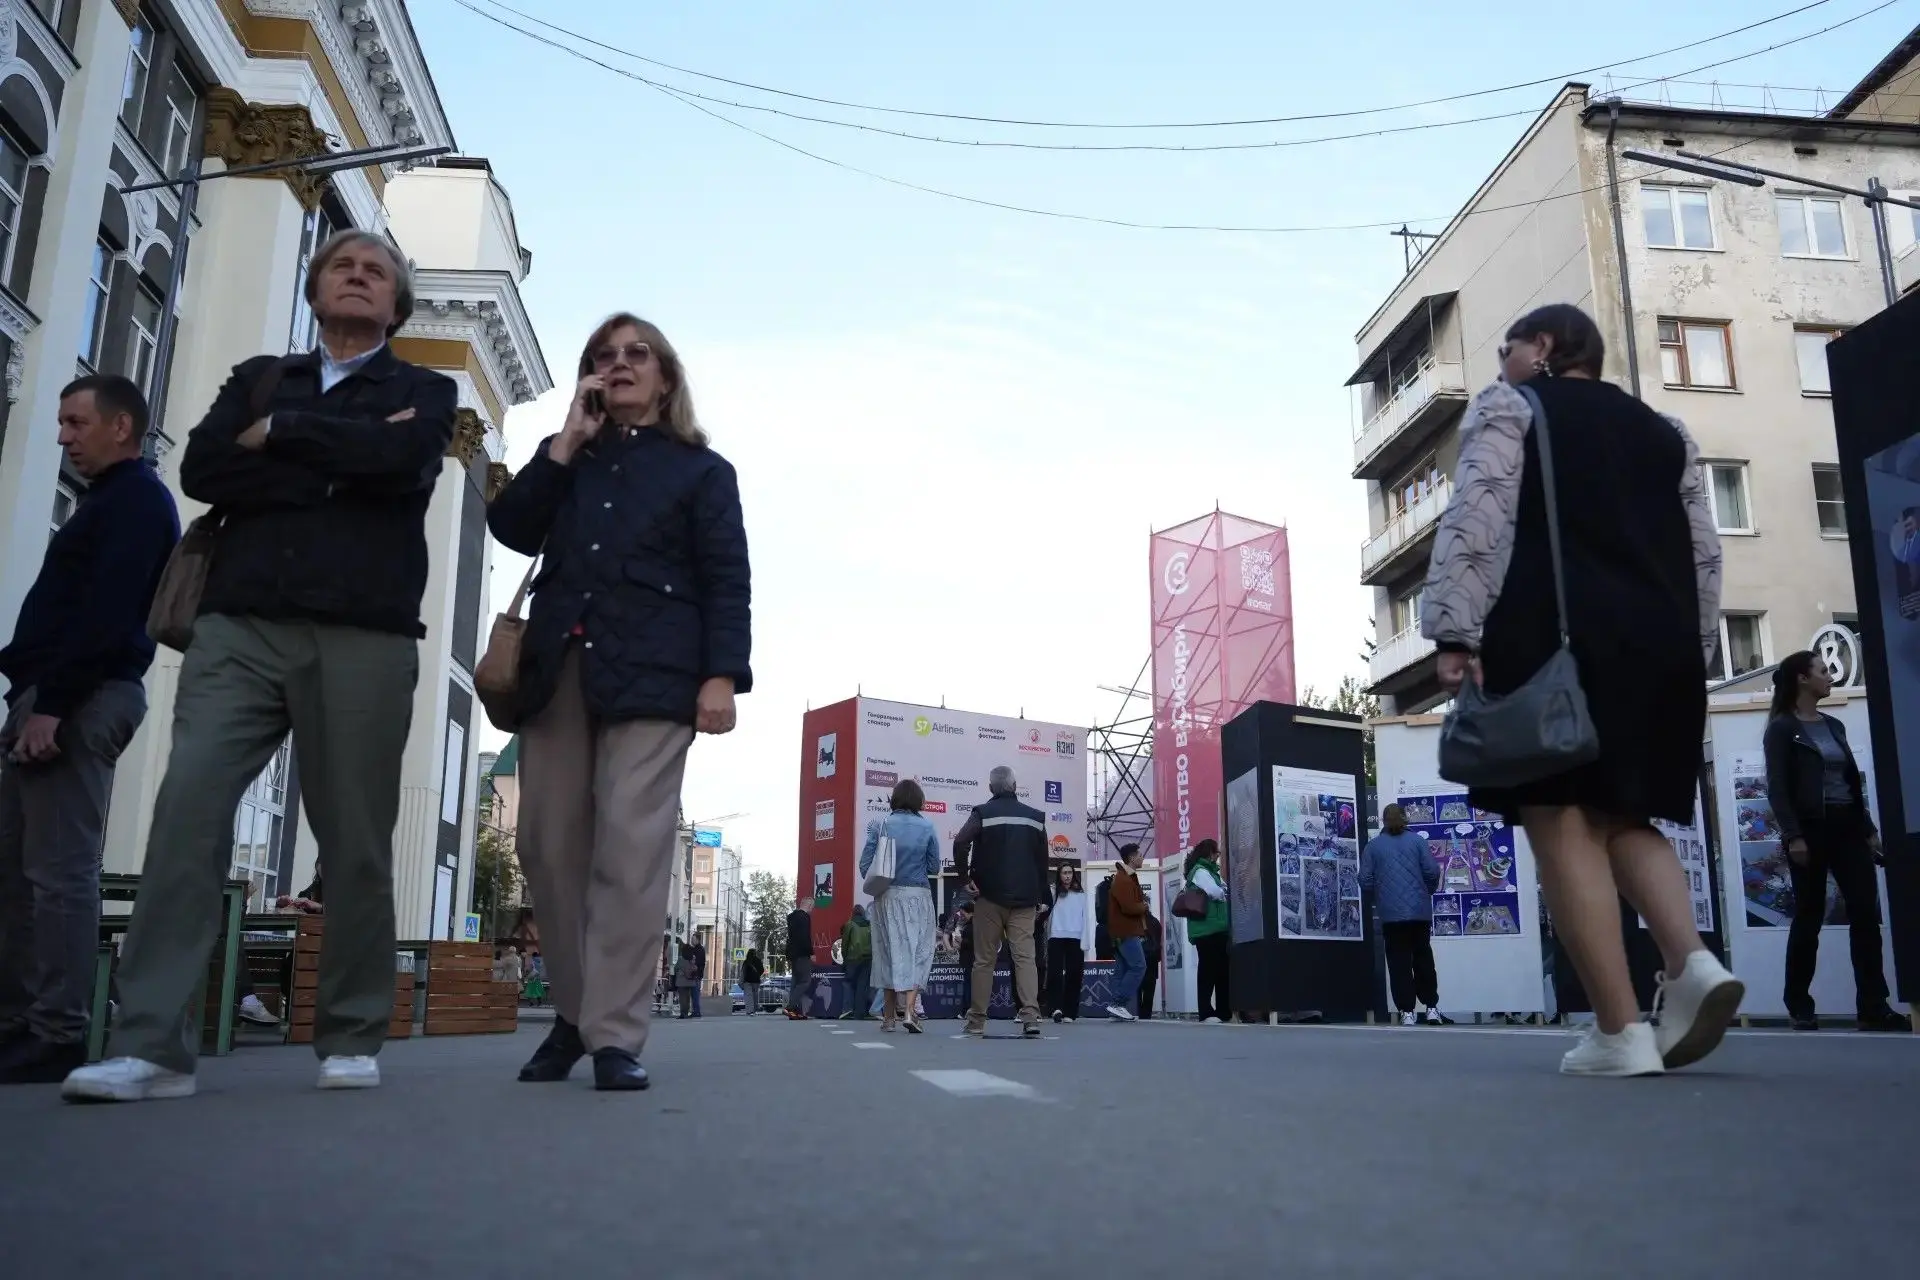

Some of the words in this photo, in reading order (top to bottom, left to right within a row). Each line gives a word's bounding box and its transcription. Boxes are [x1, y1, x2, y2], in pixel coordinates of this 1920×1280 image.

[867, 711, 904, 722] Генеральный
[867, 719, 891, 728] спонсор
[915, 720, 928, 732] S7
[932, 722, 965, 735] Airlines
[978, 726, 1005, 735] Спонсоры
[1176, 753, 1193, 851] чество
